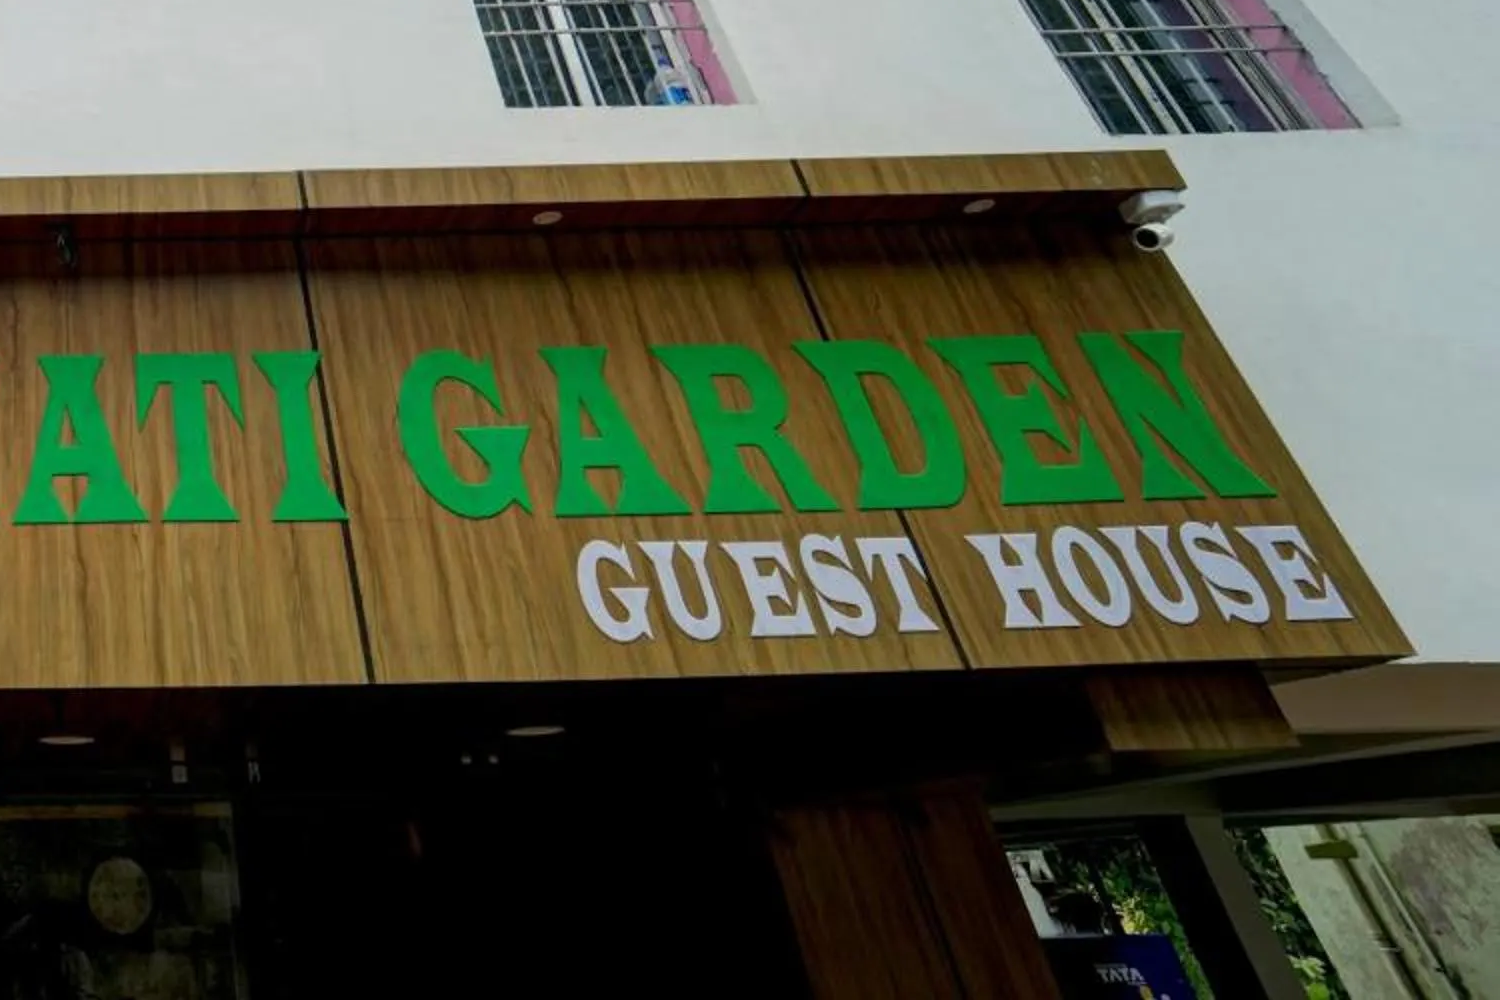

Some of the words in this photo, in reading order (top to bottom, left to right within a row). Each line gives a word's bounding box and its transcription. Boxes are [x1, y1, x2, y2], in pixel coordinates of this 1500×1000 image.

[398, 329, 1277, 519] GARDEN
[577, 533, 945, 642] GUEST
[965, 521, 1353, 628] HOUSE
[1095, 966, 1146, 985] TATA
